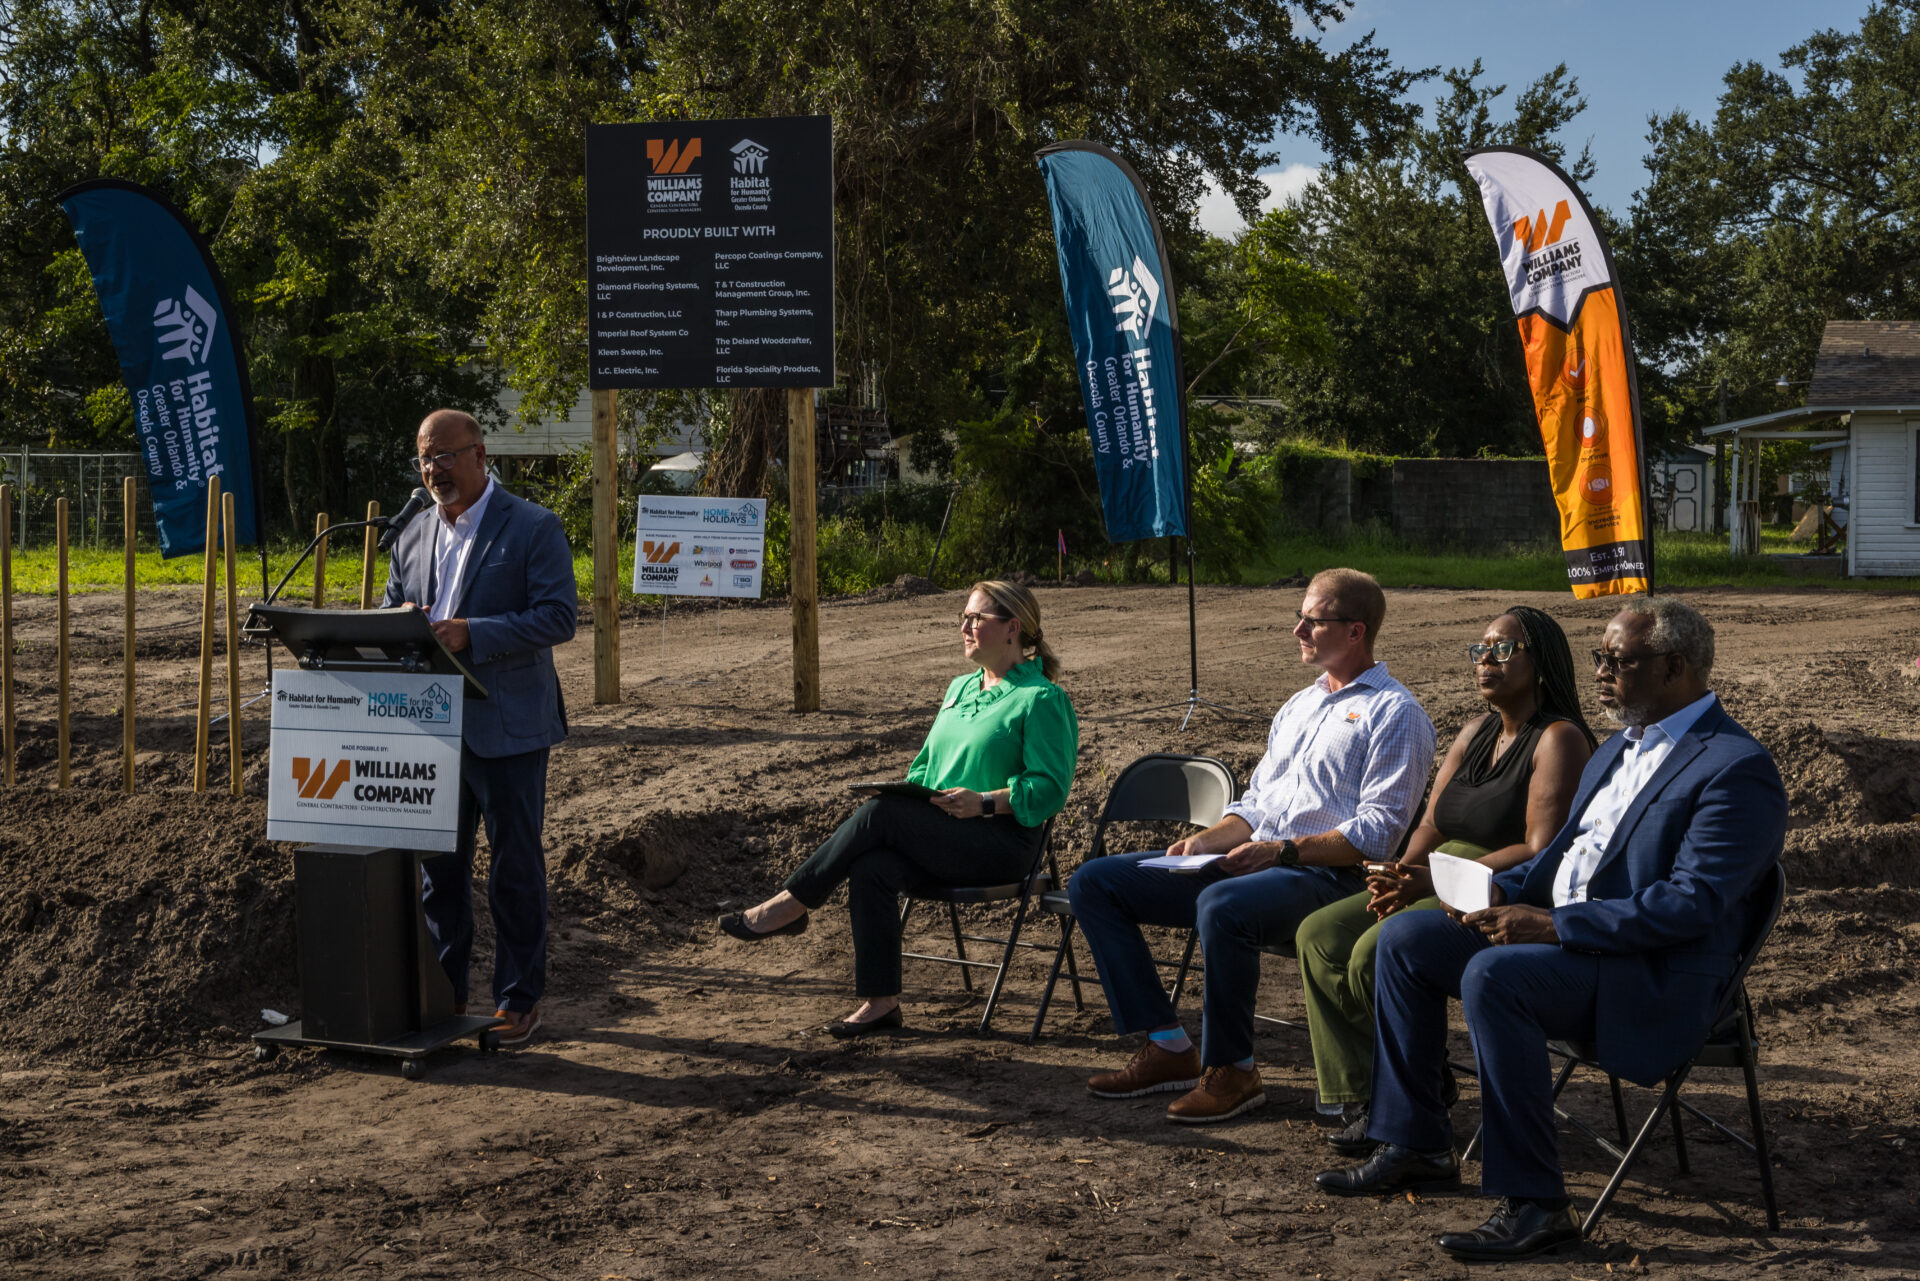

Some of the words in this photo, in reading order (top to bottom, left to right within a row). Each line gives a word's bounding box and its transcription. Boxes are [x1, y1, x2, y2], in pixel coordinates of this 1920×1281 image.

[647, 178, 702, 190] WILLIAMS
[730, 177, 770, 188] Habitat
[647, 190, 702, 202] COMPANY
[644, 228, 701, 239] PROUDLY
[705, 227, 739, 238] BUILT
[742, 226, 775, 236] WITH
[597, 255, 637, 263] Brightview
[639, 254, 680, 262] Landscape
[715, 253, 746, 261] Percopo
[749, 252, 782, 260] Coatings
[784, 251, 823, 259] Company,
[1522, 242, 1580, 273] WILLIAMS
[597, 265, 649, 273] Development,
[1527, 255, 1581, 285] COMPANY
[597, 283, 631, 291] Diamond
[633, 282, 664, 291] Flooring
[666, 282, 699, 290] Systems,
[736, 280, 785, 288] Construction
[715, 290, 766, 299] Management
[715, 309, 738, 318] Tharp
[740, 308, 777, 317] Plumbing
[779, 308, 813, 317] Systems,
[598, 330, 629, 338] Imperial
[649, 329, 677, 338] System
[761, 337, 812, 345] Woodcrafter,
[621, 349, 648, 357] Sweep,
[1122, 352, 1133, 376] for
[614, 367, 643, 375] Electric,
[744, 366, 781, 374] Speciality
[784, 365, 820, 373] Products,
[1105, 357, 1121, 402] Greater
[169, 379, 185, 402] for
[1086, 361, 1104, 408] Osceola
[1095, 412, 1111, 454] County
[187, 370, 224, 479] Habitat
[137, 389, 154, 433] Osceola
[146, 436, 163, 476] County
[1114, 406, 1131, 454] Orlando
[152, 384, 171, 427] Greater
[164, 430, 184, 476] Orlando
[176, 480, 187, 490] &
[1122, 459, 1133, 469] &
[695, 560, 722, 568] Whirlpool
[642, 566, 678, 574] WILLIAMS
[1568, 567, 1591, 577] 100%
[289, 694, 314, 702] Habitat
[368, 693, 407, 705] HOME
[422, 698, 433, 706] the
[368, 706, 433, 718] HOLIDAYS
[355, 760, 436, 780] WILLIAMS
[354, 785, 435, 805] COMPANY
[361, 805, 402, 813] CONSTRUCTION
